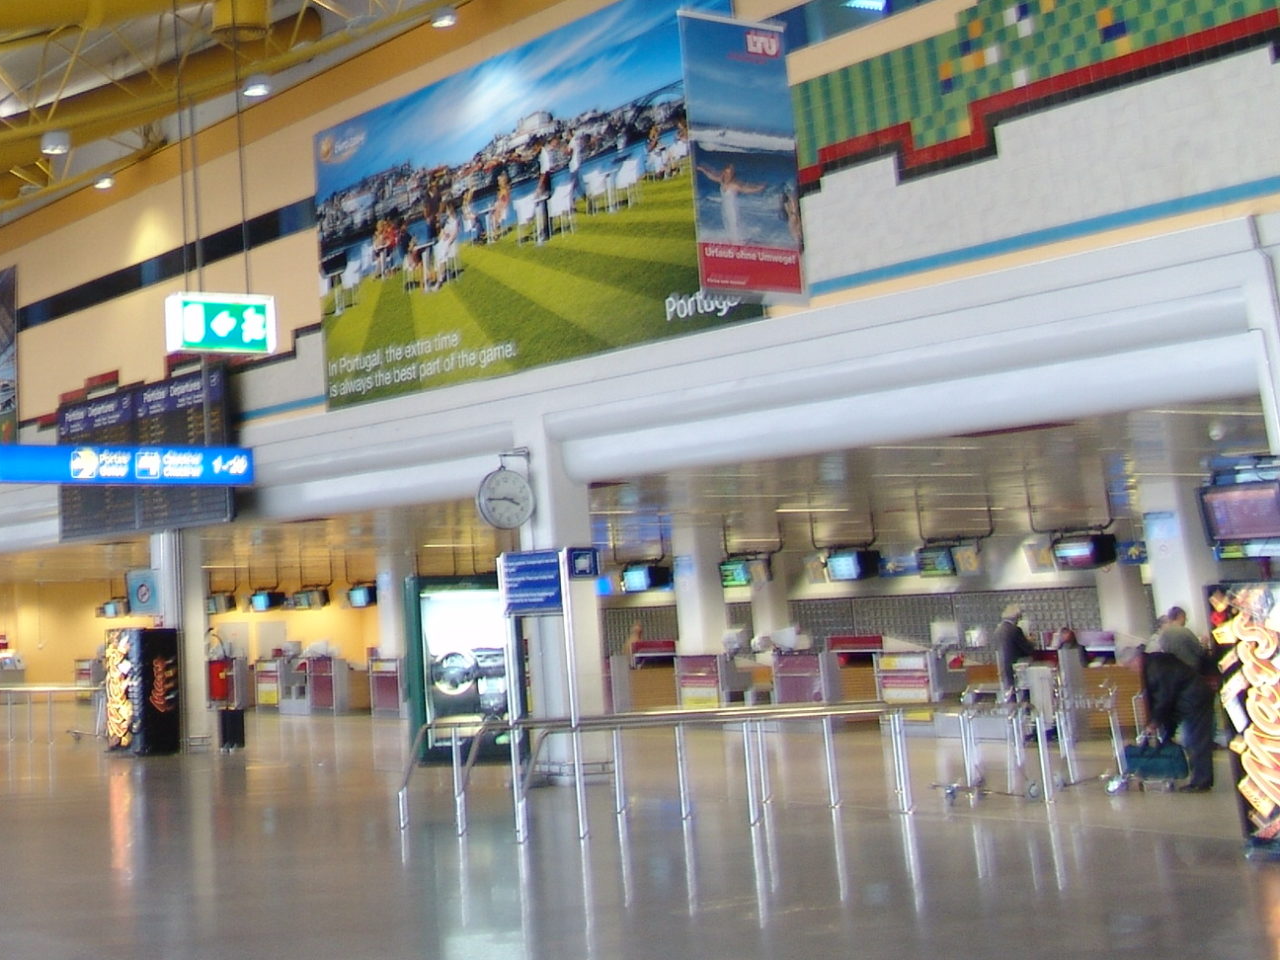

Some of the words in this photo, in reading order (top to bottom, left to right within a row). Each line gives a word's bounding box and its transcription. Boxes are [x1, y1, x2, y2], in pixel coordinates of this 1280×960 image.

[746, 34, 778, 56] LTU
[704, 247, 734, 259] Urlaub
[736, 250, 758, 261] ohne
[328, 361, 337, 377] In
[385, 346, 402, 363] the
[404, 339, 432, 359] extra
[434, 332, 459, 352] time
[329, 381, 337, 398] is
[339, 376, 373, 396] always
[375, 370, 392, 388] the
[393, 364, 417, 383] best
[419, 359, 441, 381] part
[443, 355, 455, 372] of
[457, 351, 477, 369] the
[478, 342, 517, 368] game.
